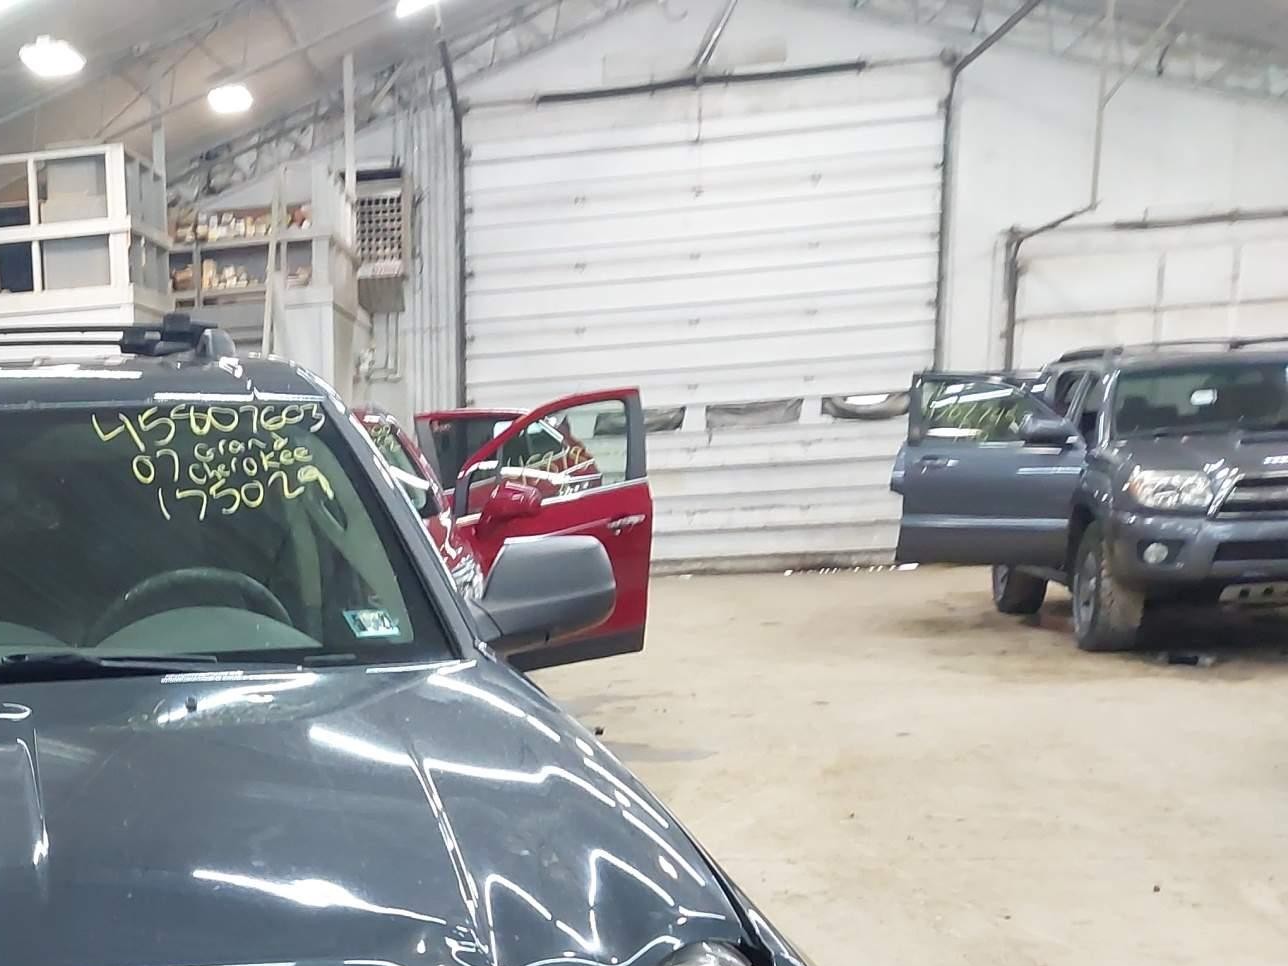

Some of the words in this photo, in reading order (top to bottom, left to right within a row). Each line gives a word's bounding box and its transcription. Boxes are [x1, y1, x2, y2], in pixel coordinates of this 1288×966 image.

[92, 403, 326, 452] 45807603
[132, 448, 180, 484] 07
[158, 465, 334, 520] 175029
